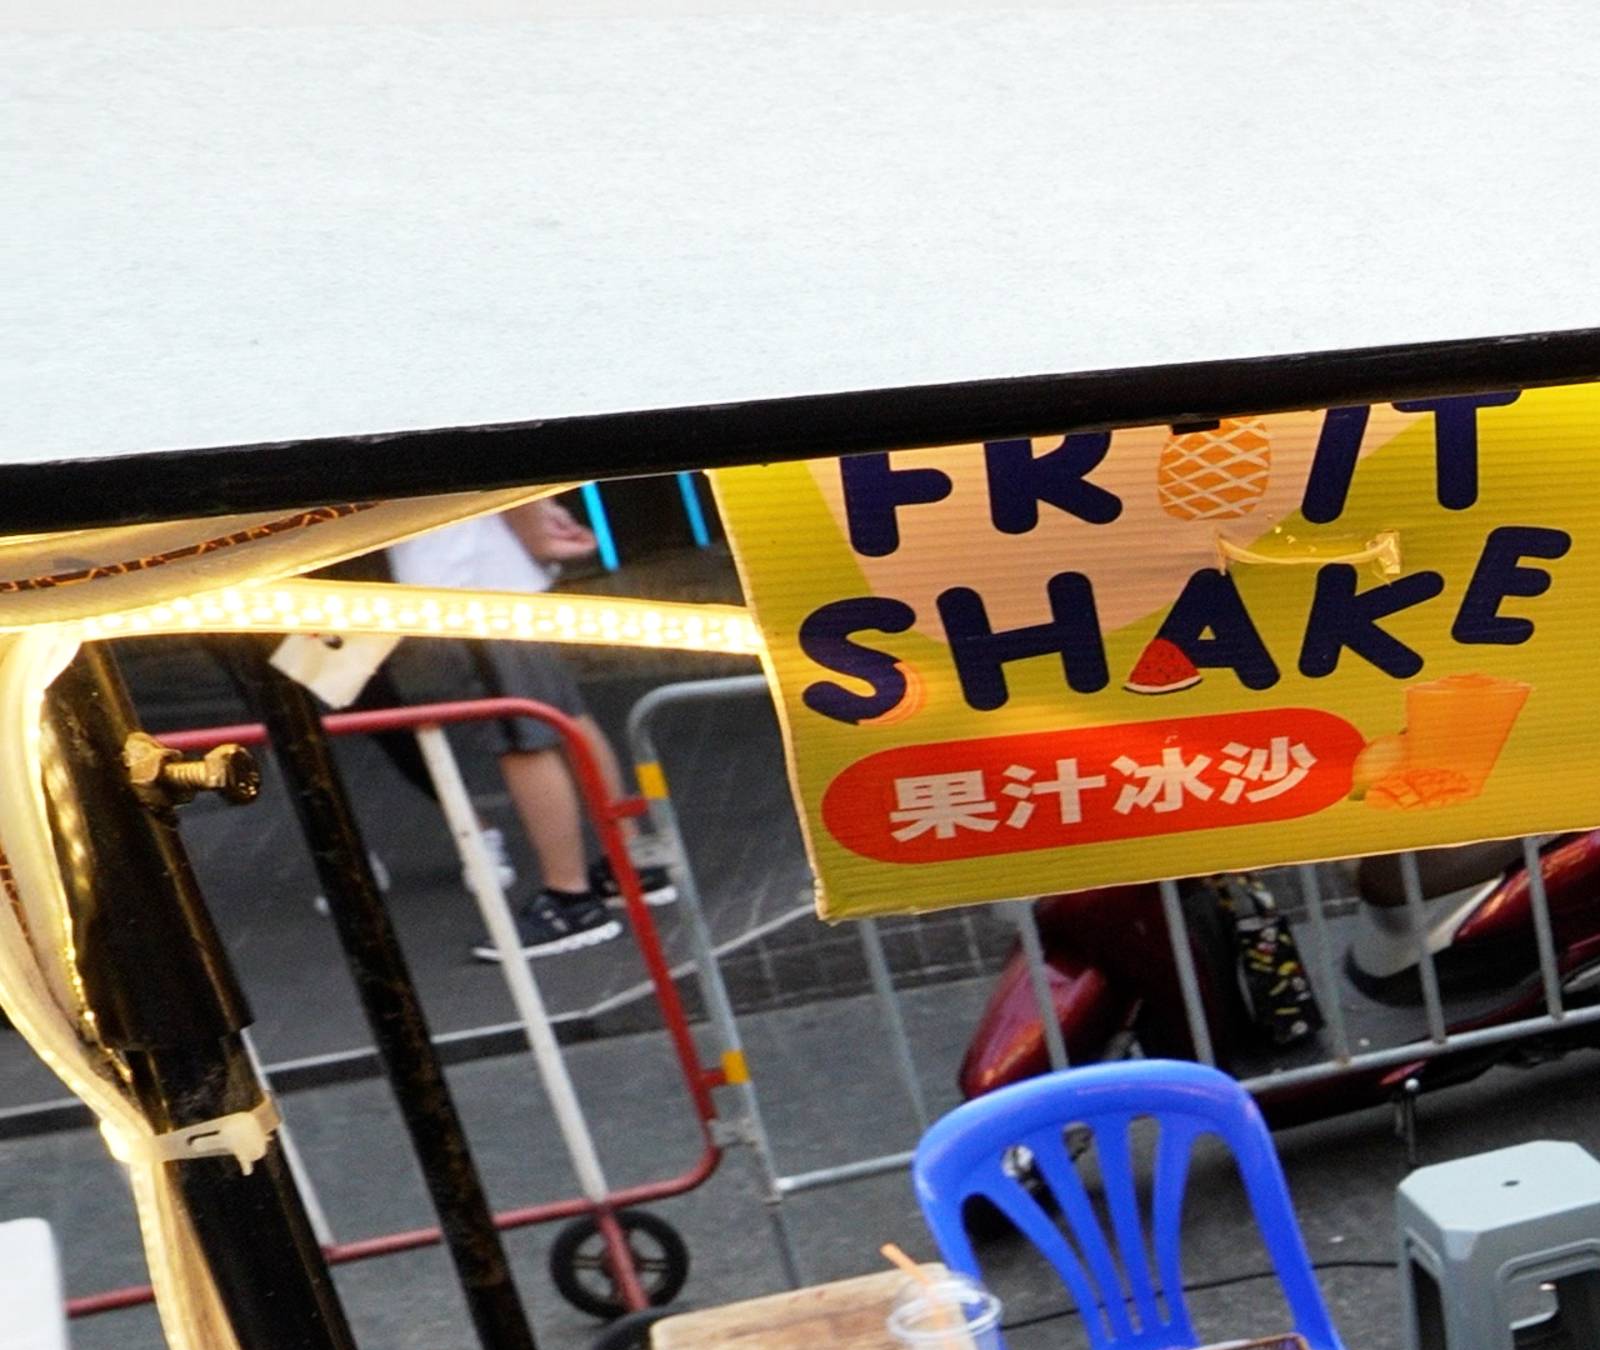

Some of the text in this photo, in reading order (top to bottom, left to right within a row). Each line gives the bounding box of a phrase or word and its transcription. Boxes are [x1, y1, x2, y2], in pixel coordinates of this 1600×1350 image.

[801, 526, 1572, 725] SHAKE
[889, 735, 1319, 845] 果汁冰沙
